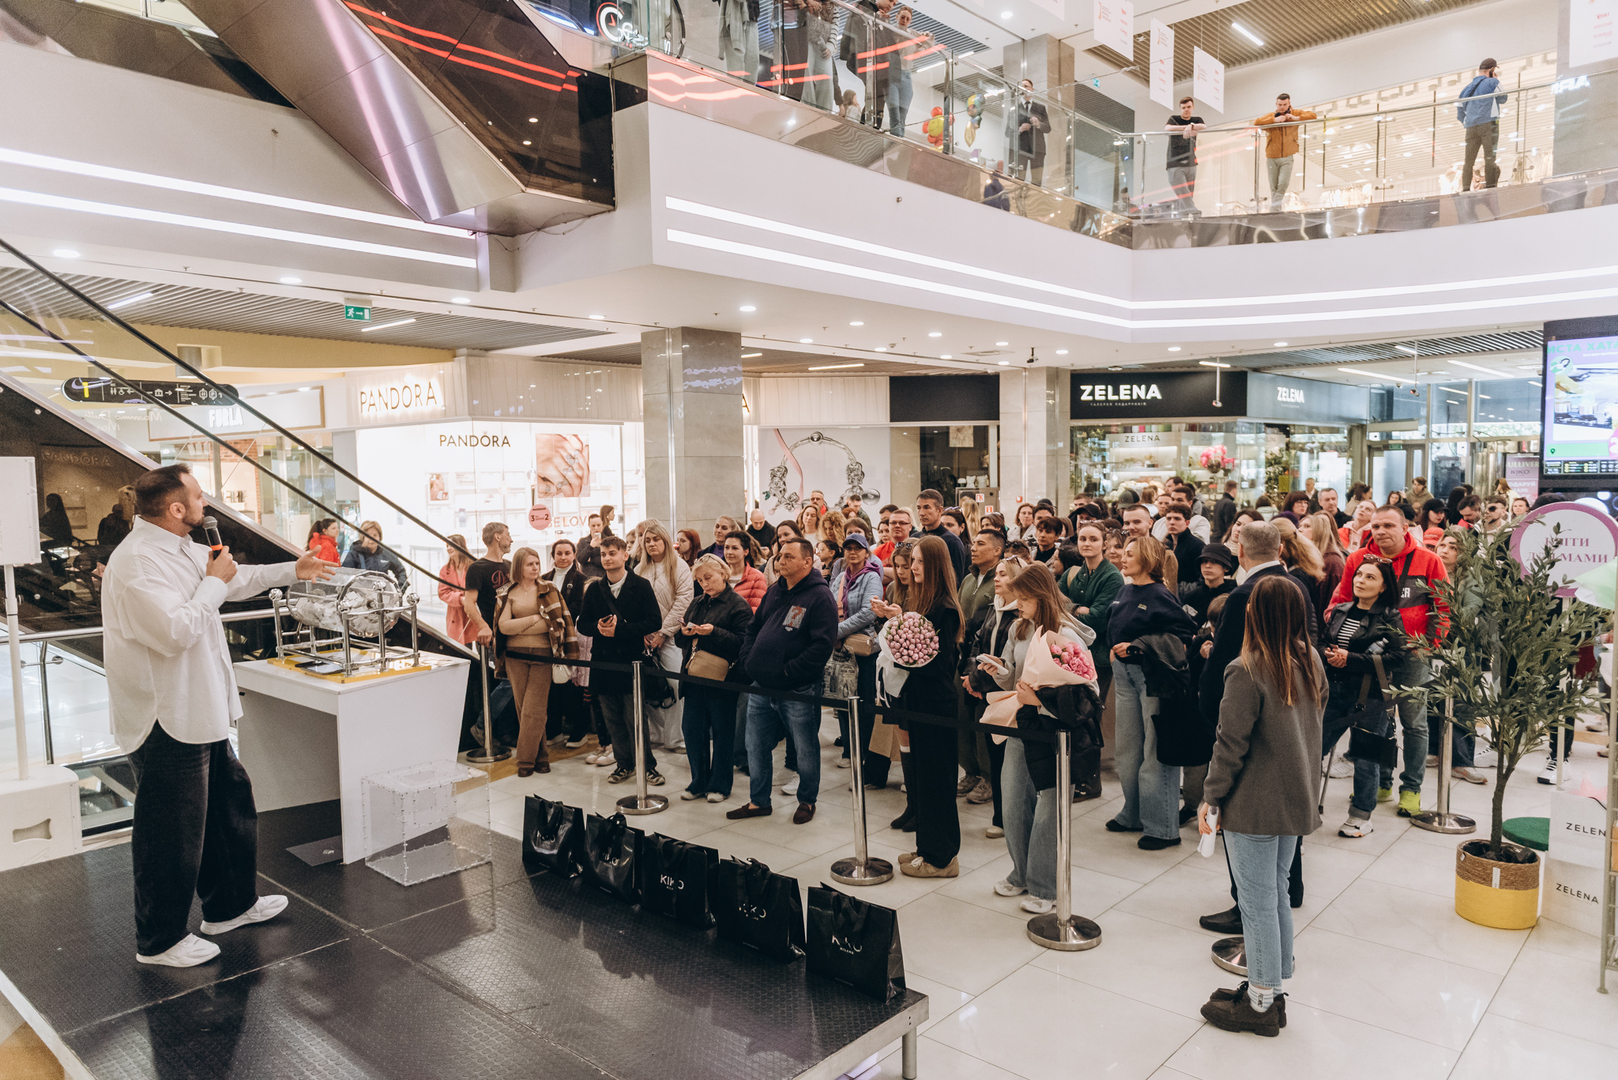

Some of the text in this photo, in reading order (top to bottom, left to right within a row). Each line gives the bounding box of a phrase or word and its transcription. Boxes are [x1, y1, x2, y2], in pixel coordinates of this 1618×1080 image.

[360, 381, 438, 414] PANDORA
[1080, 384, 1162, 401] ZELENA
[1277, 386, 1305, 404] ZELENA
[208, 408, 244, 428] FURLA
[439, 433, 511, 448] PANDORA
[1124, 435, 1161, 443] ZELENA
[1545, 537, 1590, 547] КІТИ
[1561, 553, 1608, 563] МАМИ
[1566, 822, 1607, 837] ZELEN
[1556, 882, 1600, 905] ZELENA
